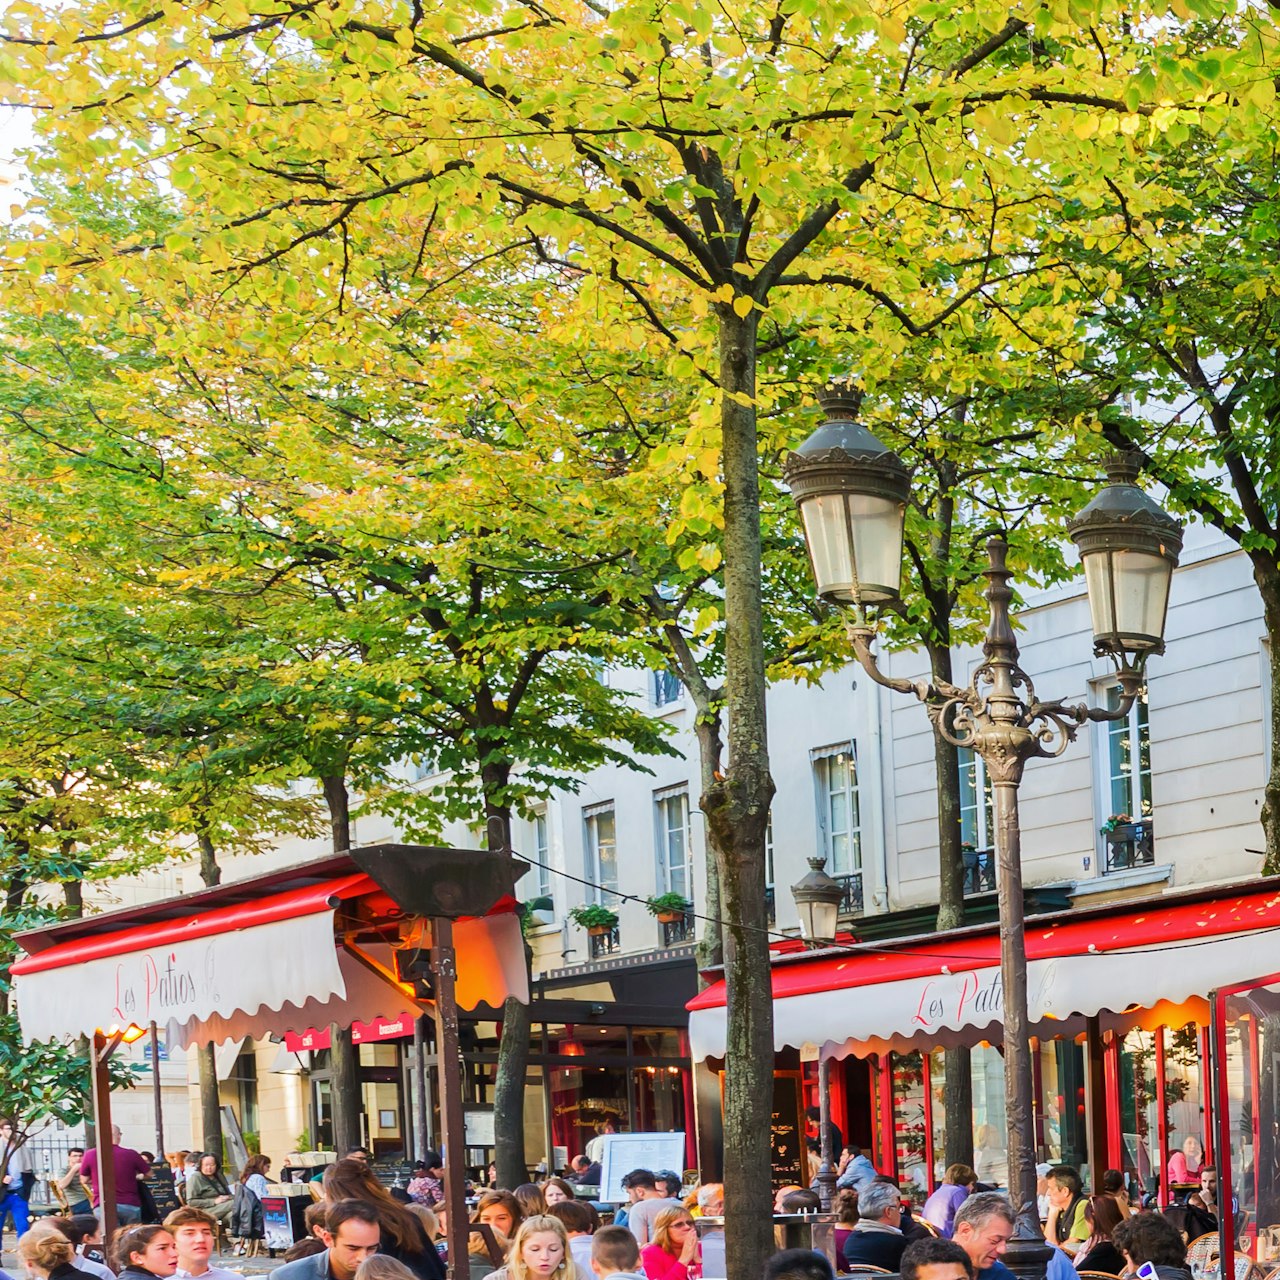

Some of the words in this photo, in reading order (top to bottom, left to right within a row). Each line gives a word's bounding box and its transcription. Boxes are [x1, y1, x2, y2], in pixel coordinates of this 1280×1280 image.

[112, 964, 137, 1020] Les
[140, 952, 196, 1018] Patios
[912, 981, 944, 1026] Les
[956, 971, 1004, 1022] Pati
